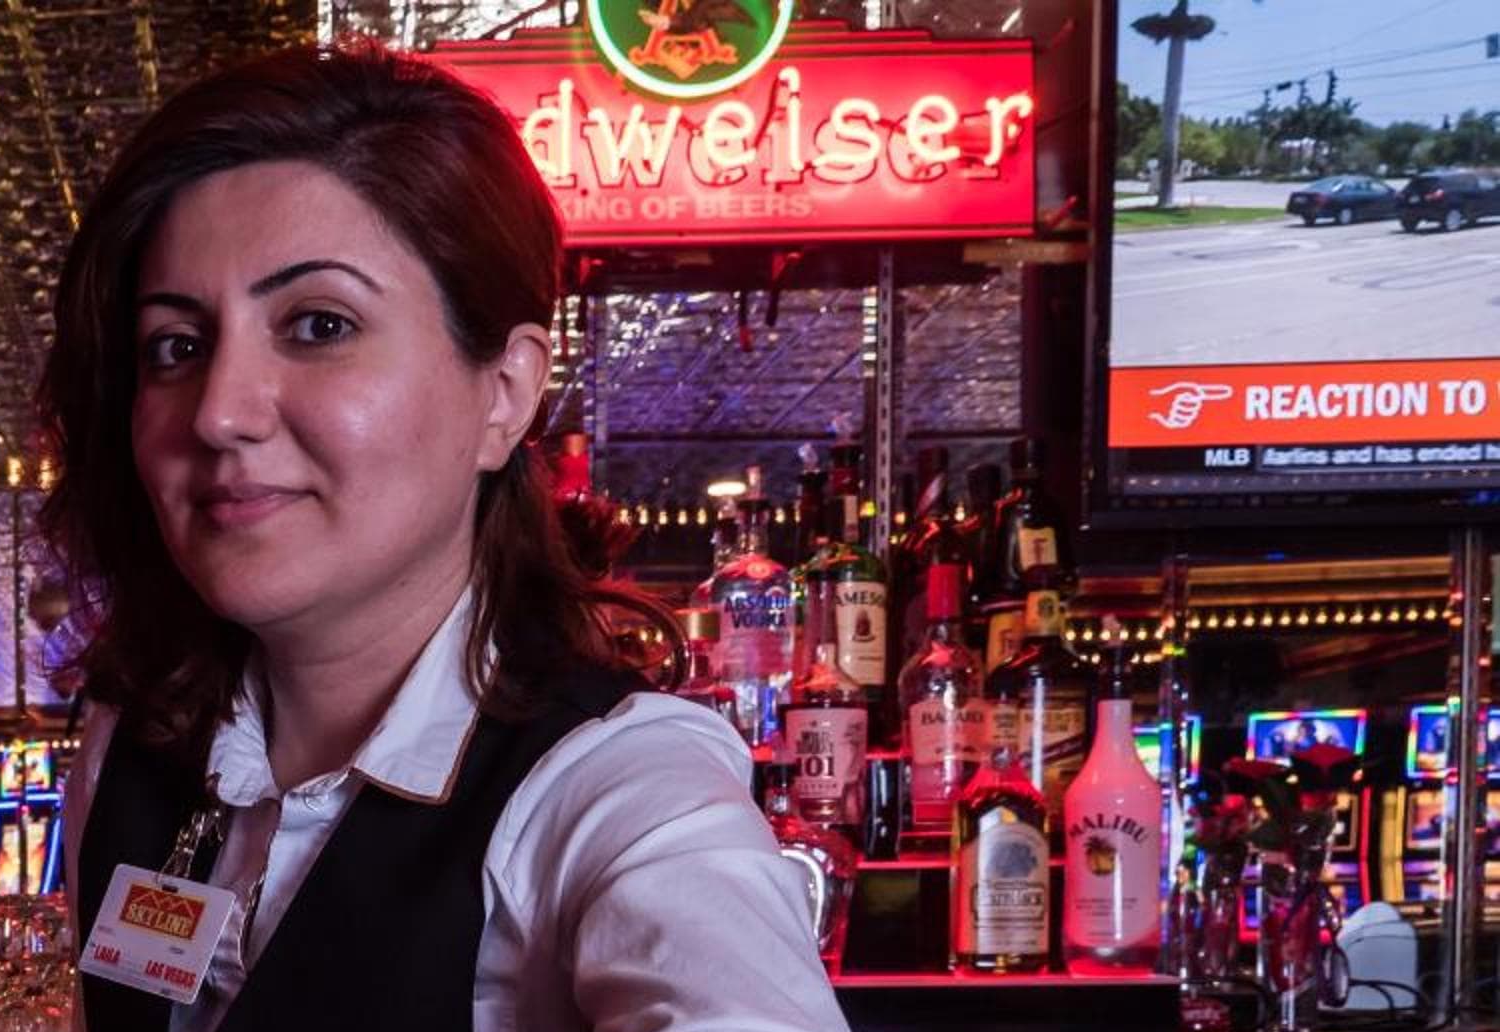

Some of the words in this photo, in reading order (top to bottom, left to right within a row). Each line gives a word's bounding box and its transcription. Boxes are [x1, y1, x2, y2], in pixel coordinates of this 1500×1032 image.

[522, 67, 1033, 186] dweiser
[640, 194, 686, 220] OF
[695, 193, 813, 219] BEERS
[1244, 383, 1428, 421] REACTION
[1439, 379, 1487, 415] TO
[1205, 447, 1251, 467] MLB
[1332, 446, 1372, 464] and
[1376, 445, 1413, 463] has
[1417, 443, 1482, 462] ended
[1068, 813, 1151, 844] MALIBU
